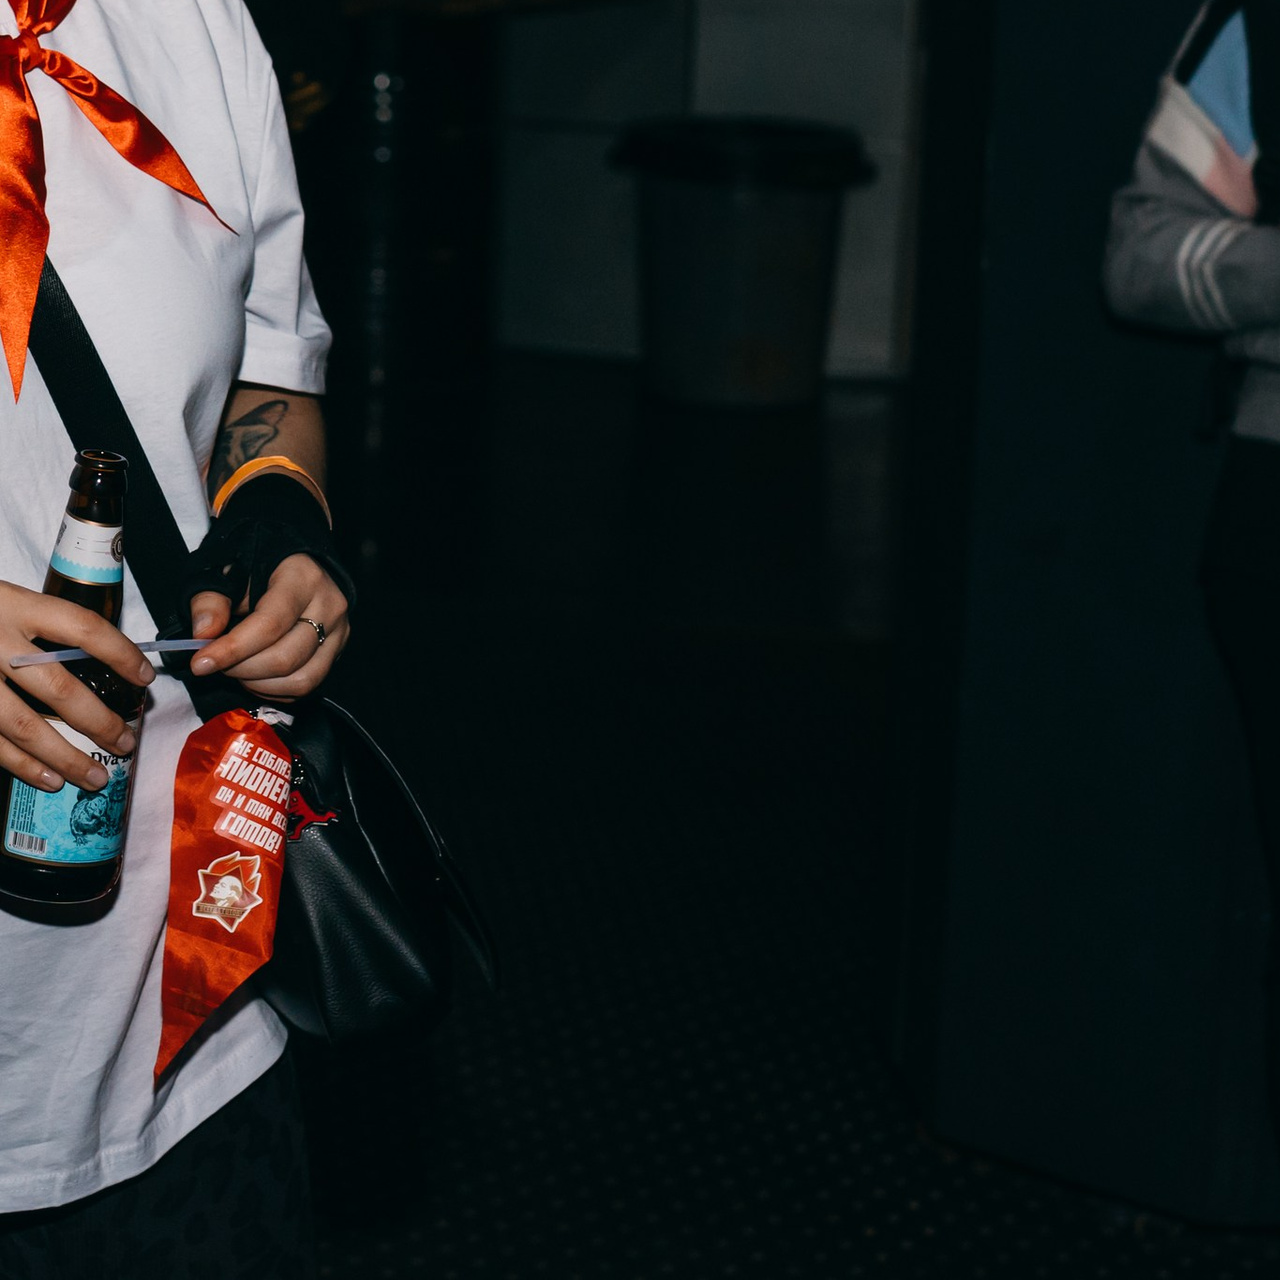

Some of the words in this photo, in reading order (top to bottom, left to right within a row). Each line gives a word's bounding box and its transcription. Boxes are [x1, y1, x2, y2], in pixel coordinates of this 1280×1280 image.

[234, 740, 254, 758] НЕ
[215, 785, 235, 804] ОН
[233, 793, 246, 808] И
[220, 811, 283, 854] ГОТОВ!
